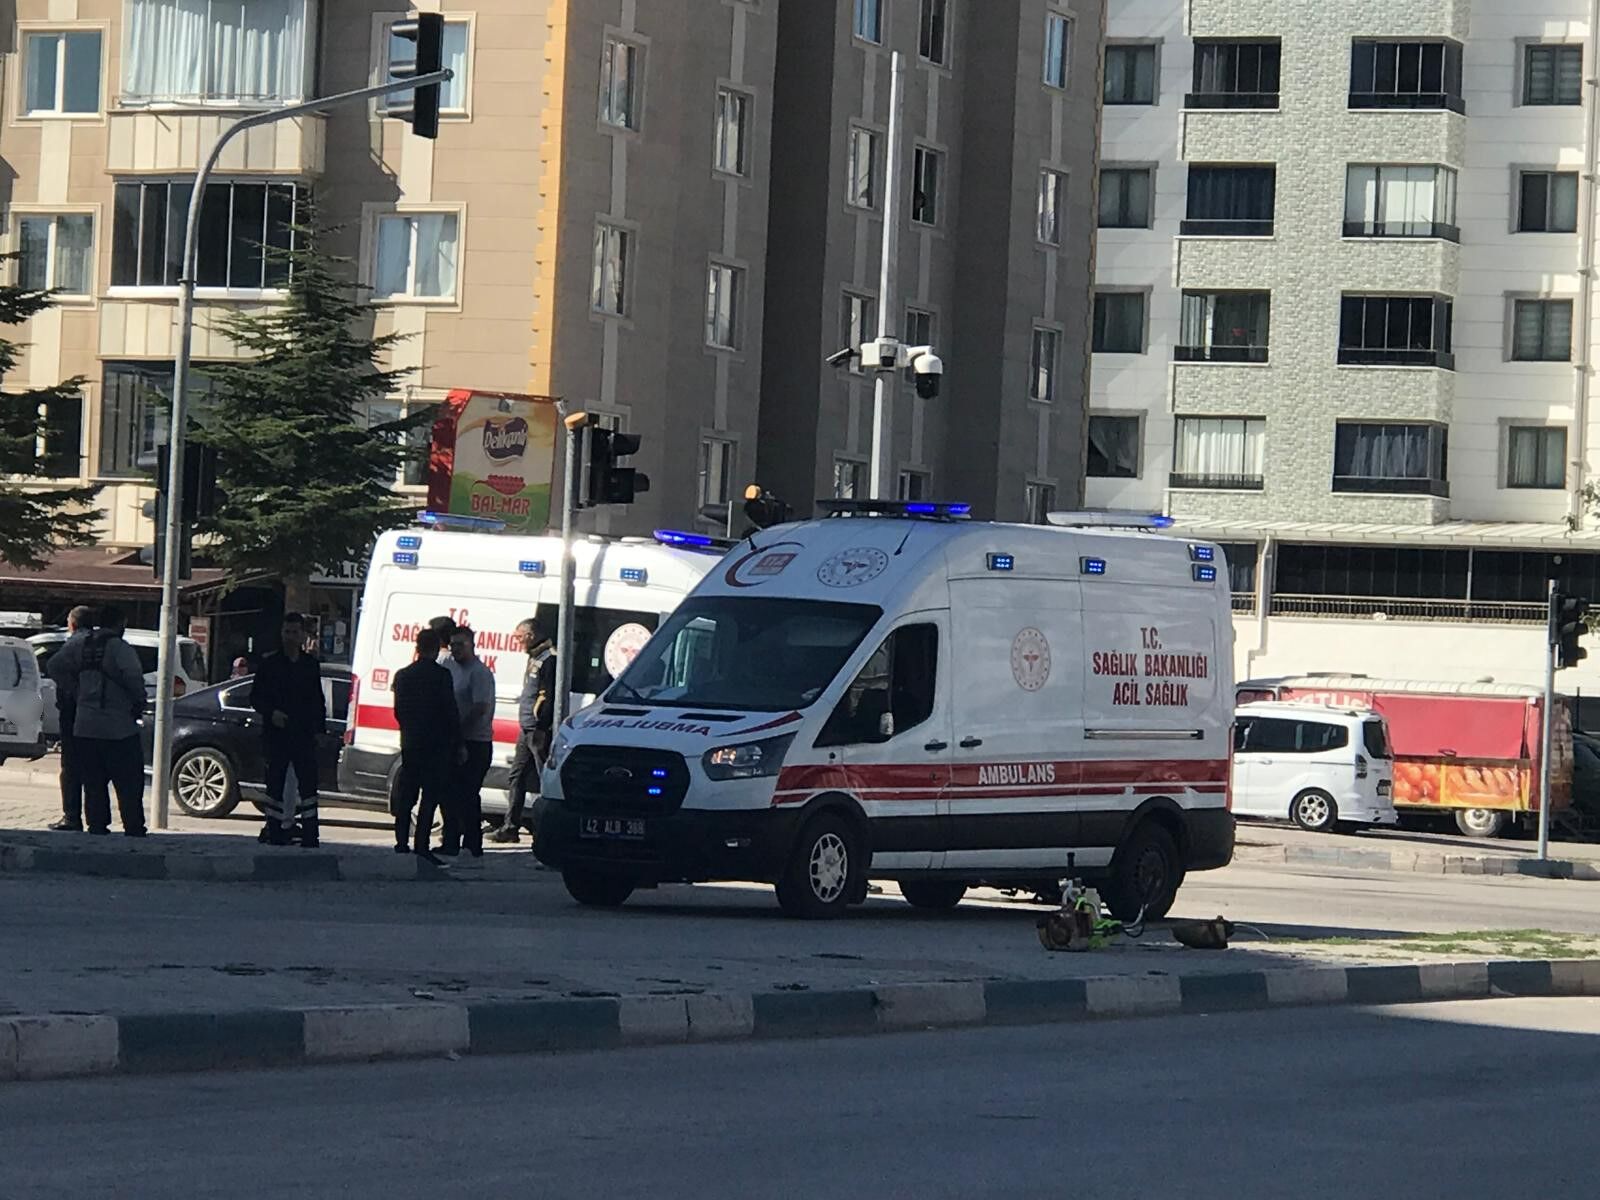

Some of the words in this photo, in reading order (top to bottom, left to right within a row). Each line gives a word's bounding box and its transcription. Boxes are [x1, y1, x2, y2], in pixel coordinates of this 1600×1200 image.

[471, 494, 530, 516] BAL-MAR
[1140, 626, 1162, 650] T.C.
[1092, 650, 1138, 676] SAĞLIK
[1144, 652, 1208, 679] BAKANLIĞI
[1112, 678, 1140, 705] ACİL
[1145, 680, 1189, 706] SAĞLIK
[978, 763, 1055, 785] AMBULANS
[585, 819, 598, 833] 42
